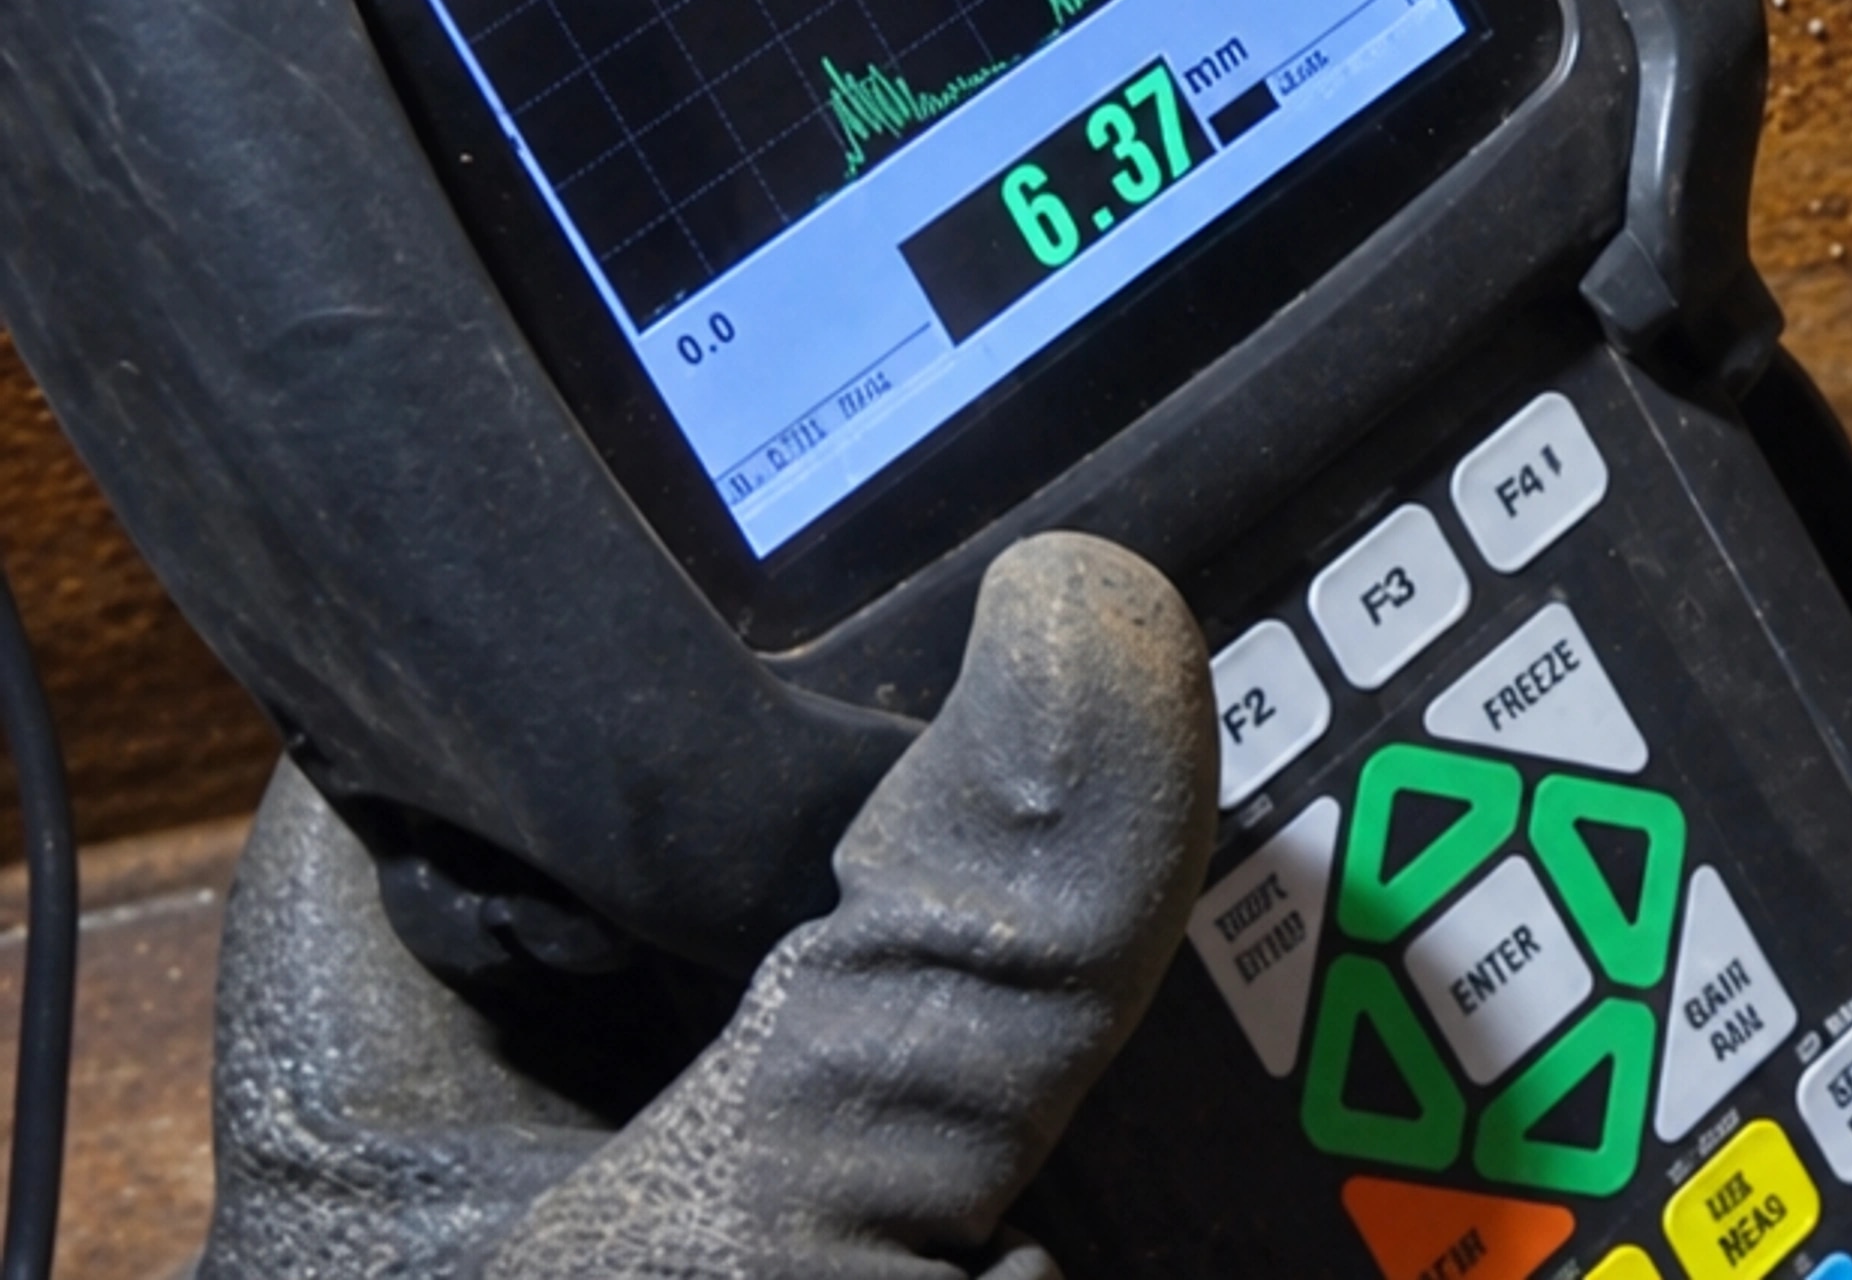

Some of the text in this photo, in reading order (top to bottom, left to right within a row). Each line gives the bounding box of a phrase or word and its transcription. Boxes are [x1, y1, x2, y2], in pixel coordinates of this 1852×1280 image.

[1001, 37, 1249, 266] 6.37 mm
[677, 311, 735, 365] 0.0
[1360, 566, 1415, 626] F3
[1221, 686, 1276, 744] F2
[1483, 639, 1581, 732] FREEZE
[1449, 924, 1542, 1016] ENTER
